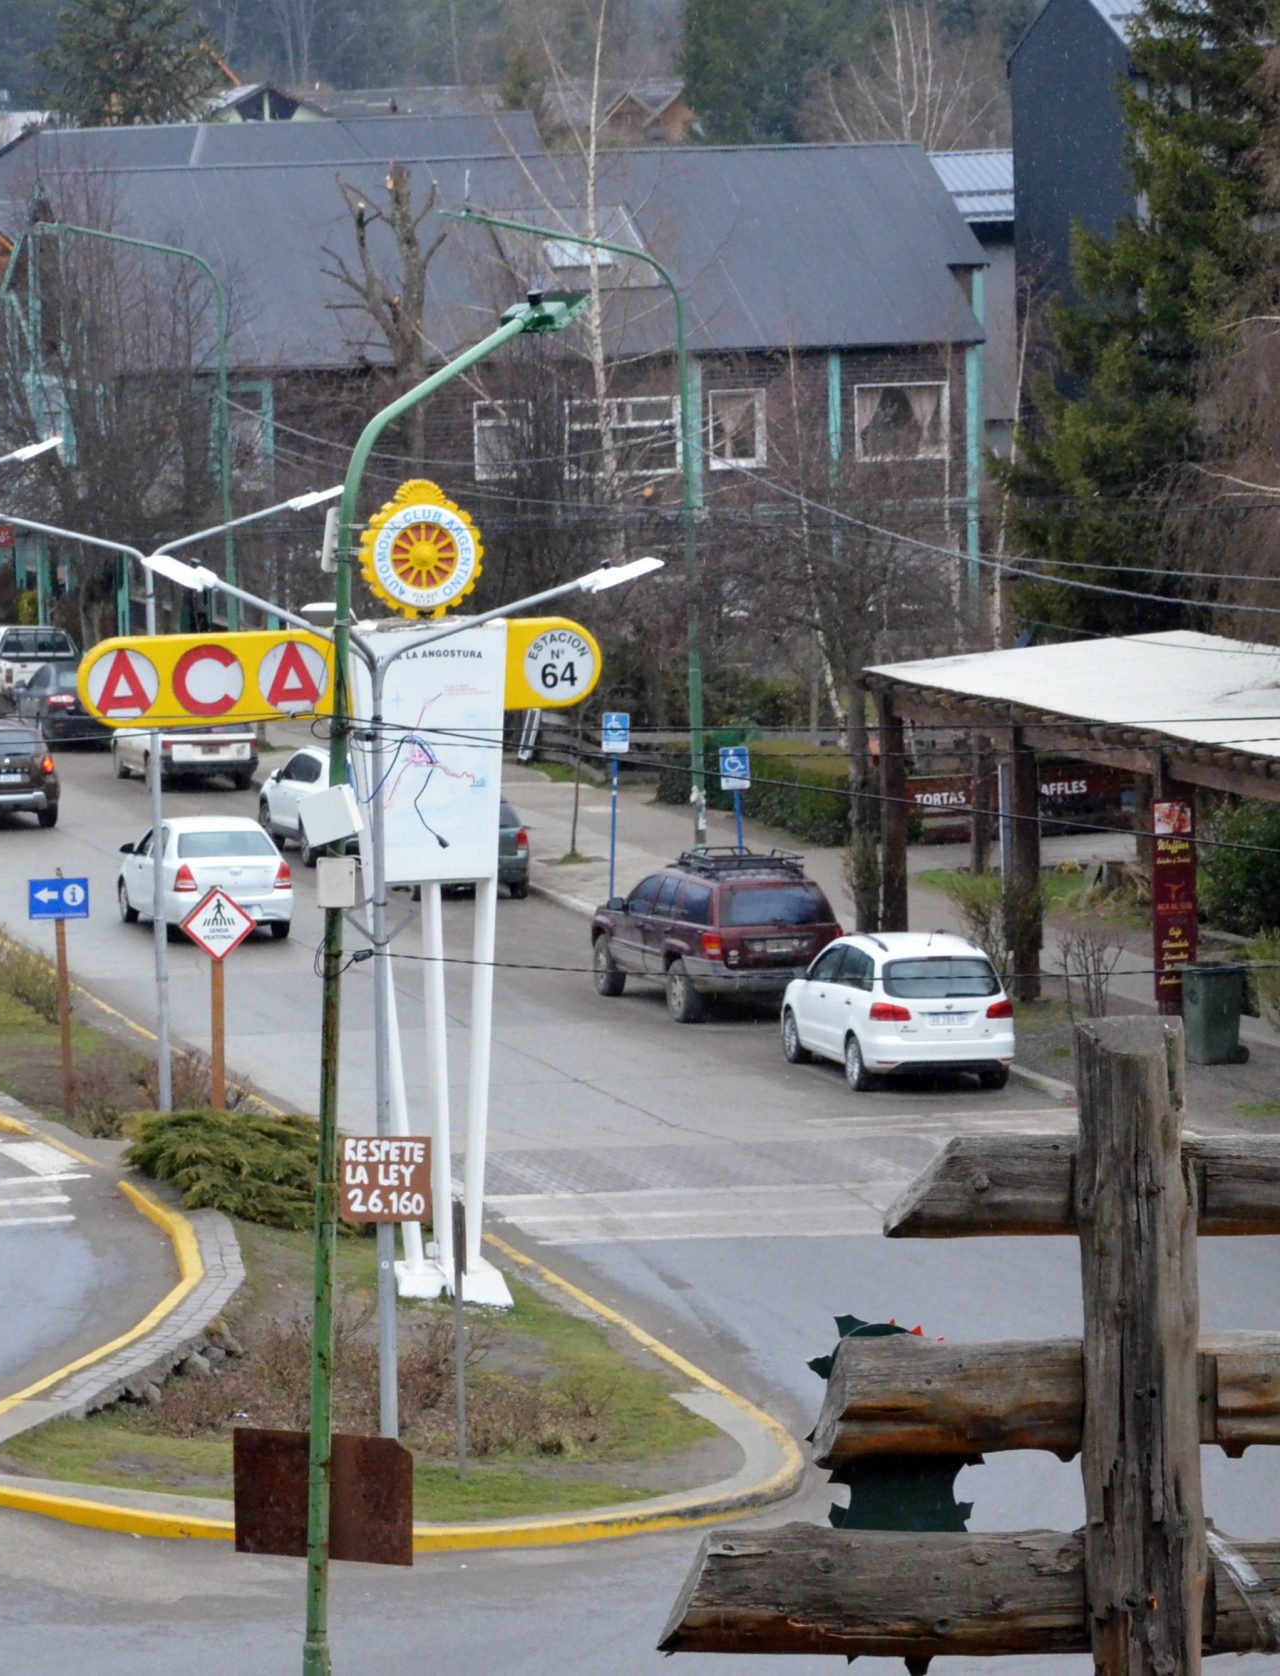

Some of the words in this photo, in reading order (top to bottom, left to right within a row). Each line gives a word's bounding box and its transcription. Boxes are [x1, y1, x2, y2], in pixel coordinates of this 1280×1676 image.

[402, 508, 442, 522] CLUB
[442, 519, 473, 597] ARGENTINO
[405, 650, 419, 660] LA
[422, 649, 483, 659] ANGOSTURA
[528, 632, 588, 661] ESTACION
[96, 639, 322, 718] ACA
[541, 661, 578, 689] 64
[914, 791, 967, 806] TORTAS
[1040, 779, 1088, 796] AFFLES
[343, 1138, 426, 1164] RESPETE
[344, 1163, 370, 1186] LA
[377, 1163, 417, 1188] LEY
[346, 1187, 426, 1216] 26.160
